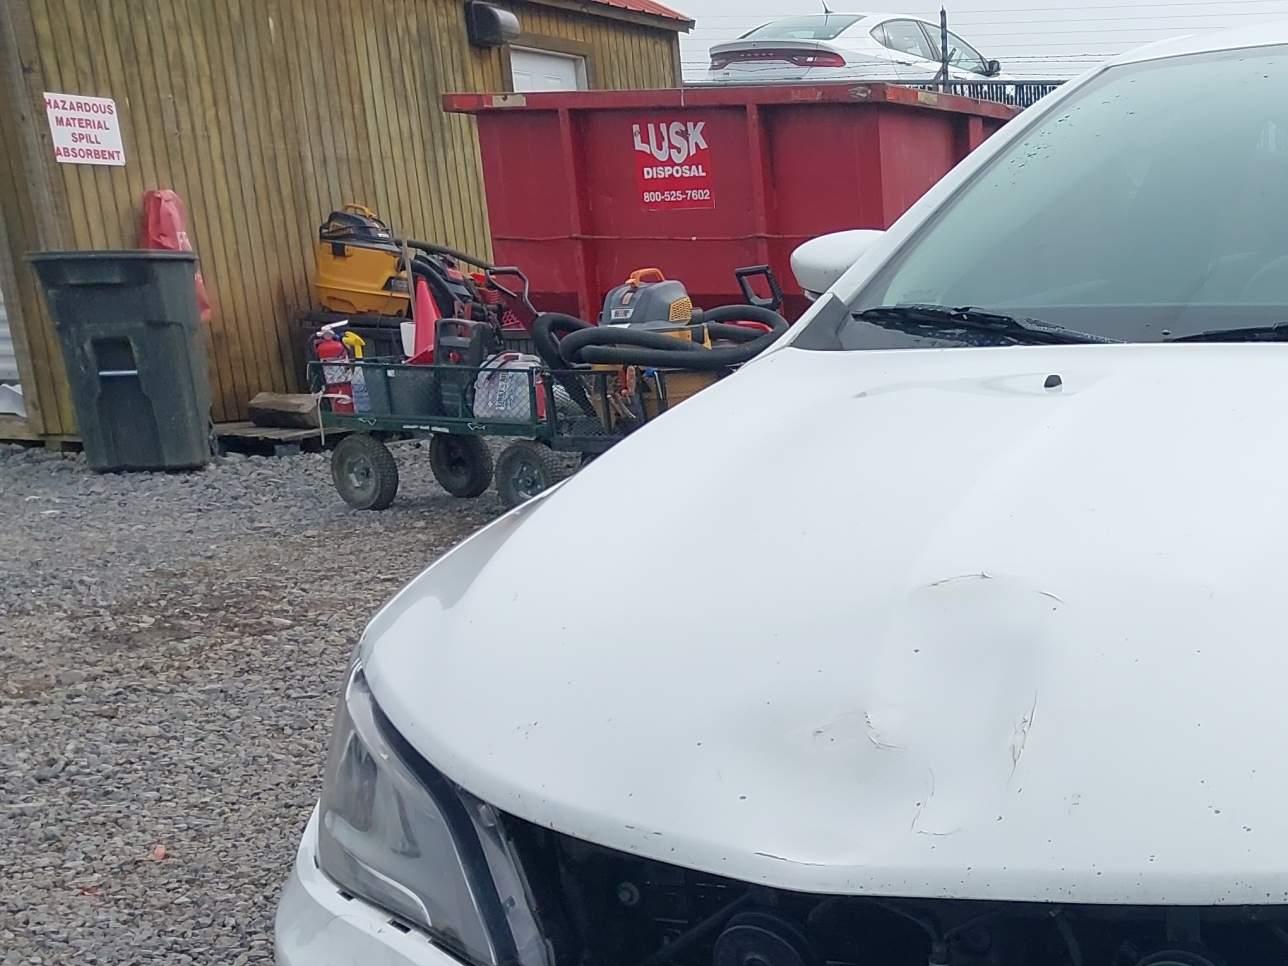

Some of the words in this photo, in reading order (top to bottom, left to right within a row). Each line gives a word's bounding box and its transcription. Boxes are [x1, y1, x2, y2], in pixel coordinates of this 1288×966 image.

[45, 98, 114, 115] HAZARDOUS
[55, 116, 110, 131] MATERIAL
[71, 131, 101, 145] SPILL
[632, 121, 708, 163] LUSK
[55, 147, 121, 160] ABSORBENT
[643, 165, 706, 179] DISPOSAL
[643, 189, 711, 203] 800-525-7602
